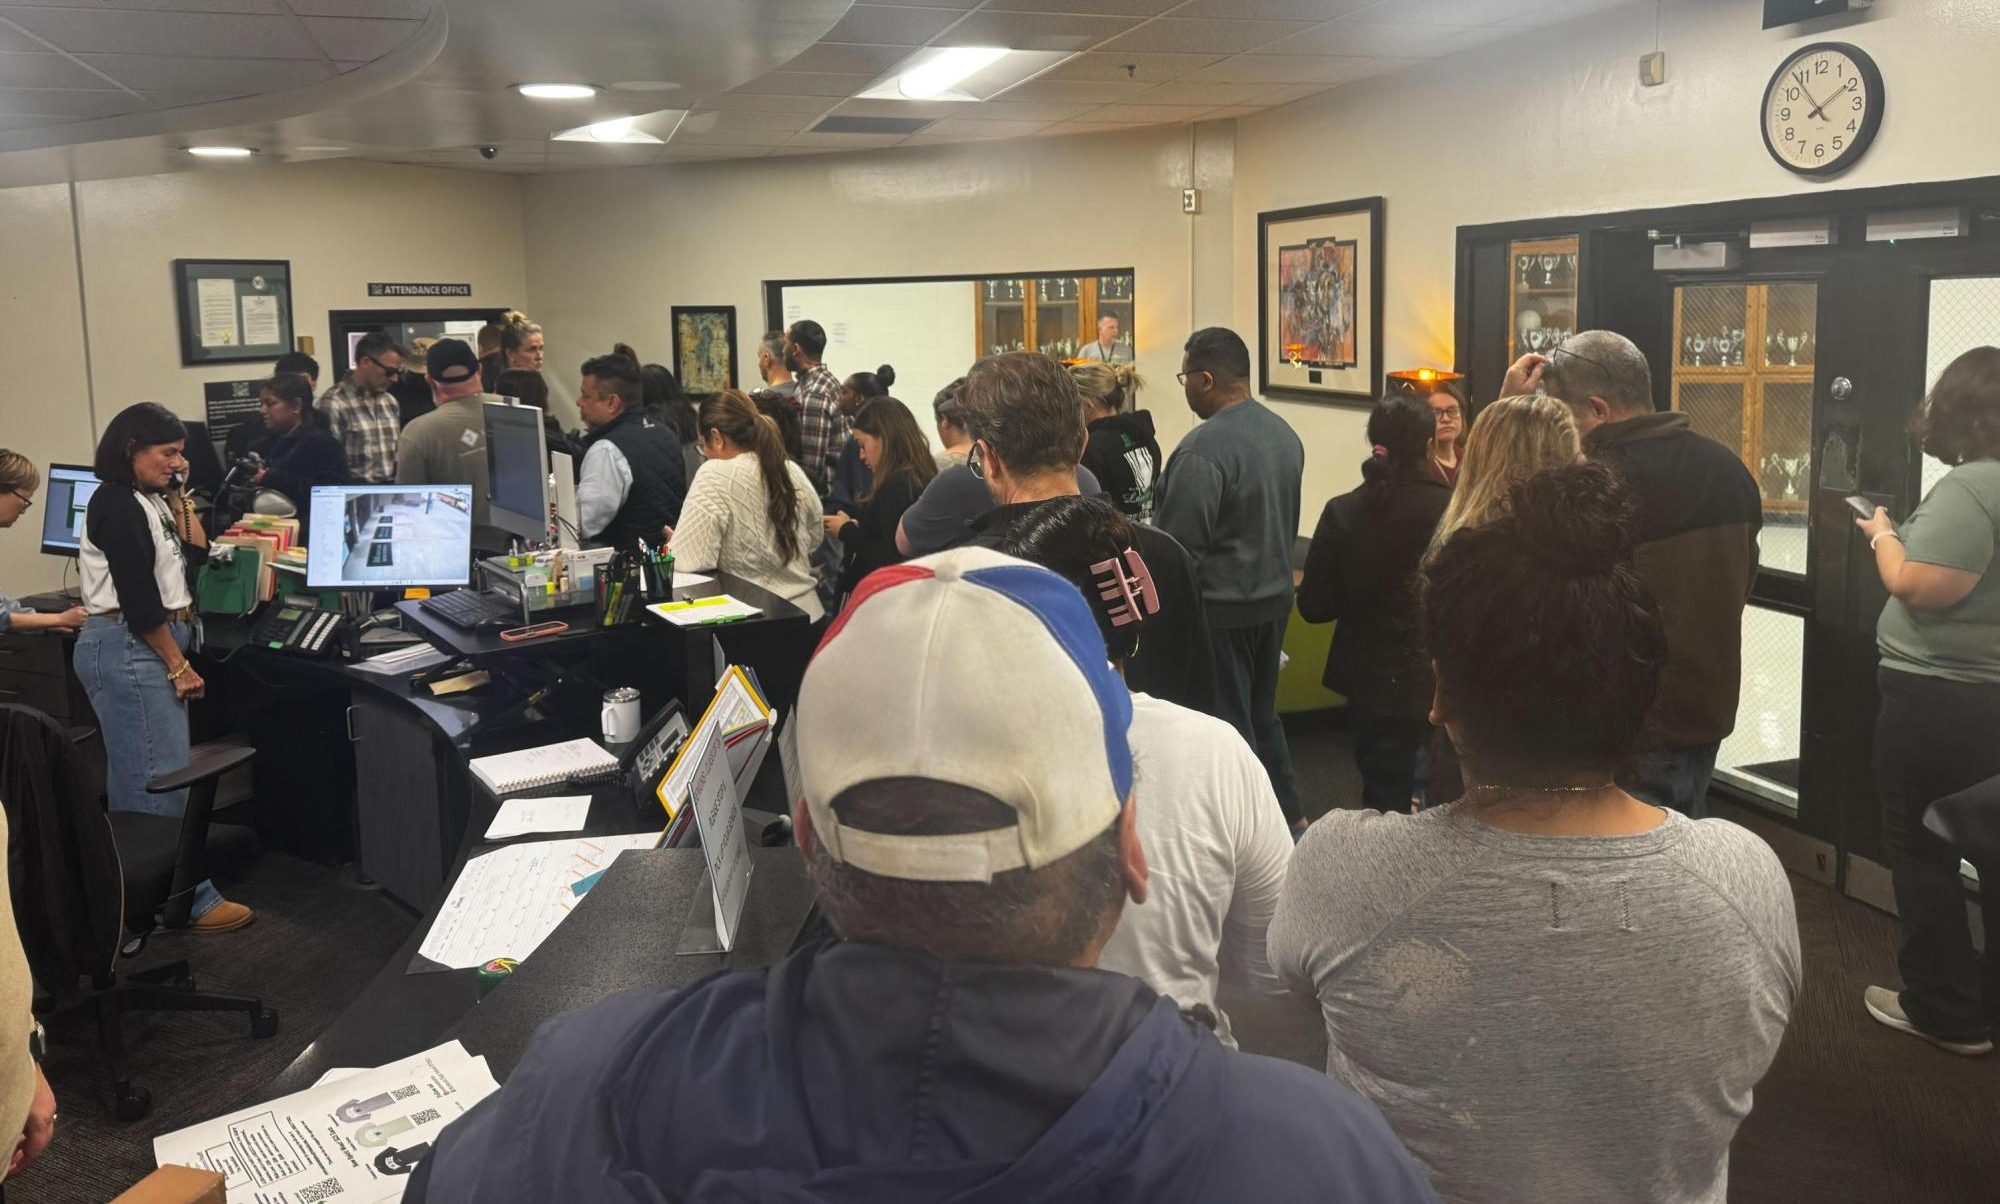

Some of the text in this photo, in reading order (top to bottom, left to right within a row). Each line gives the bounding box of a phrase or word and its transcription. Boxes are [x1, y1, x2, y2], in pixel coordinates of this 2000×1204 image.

[1814, 60, 1829, 75] 12
[1799, 70, 1809, 84] 11
[1848, 78, 1858, 92] 2
[1785, 87, 1800, 102] 10
[1852, 96, 1862, 110] 3
[1780, 108, 1790, 121] 9
[1846, 119, 1856, 132] 4
[1785, 127, 1795, 140] 8
[1798, 140, 1806, 154] 7
[1832, 136, 1842, 150] 5
[1814, 144, 1824, 157] 6
[384, 286, 468, 294] ATTENDANCE OFFICE
